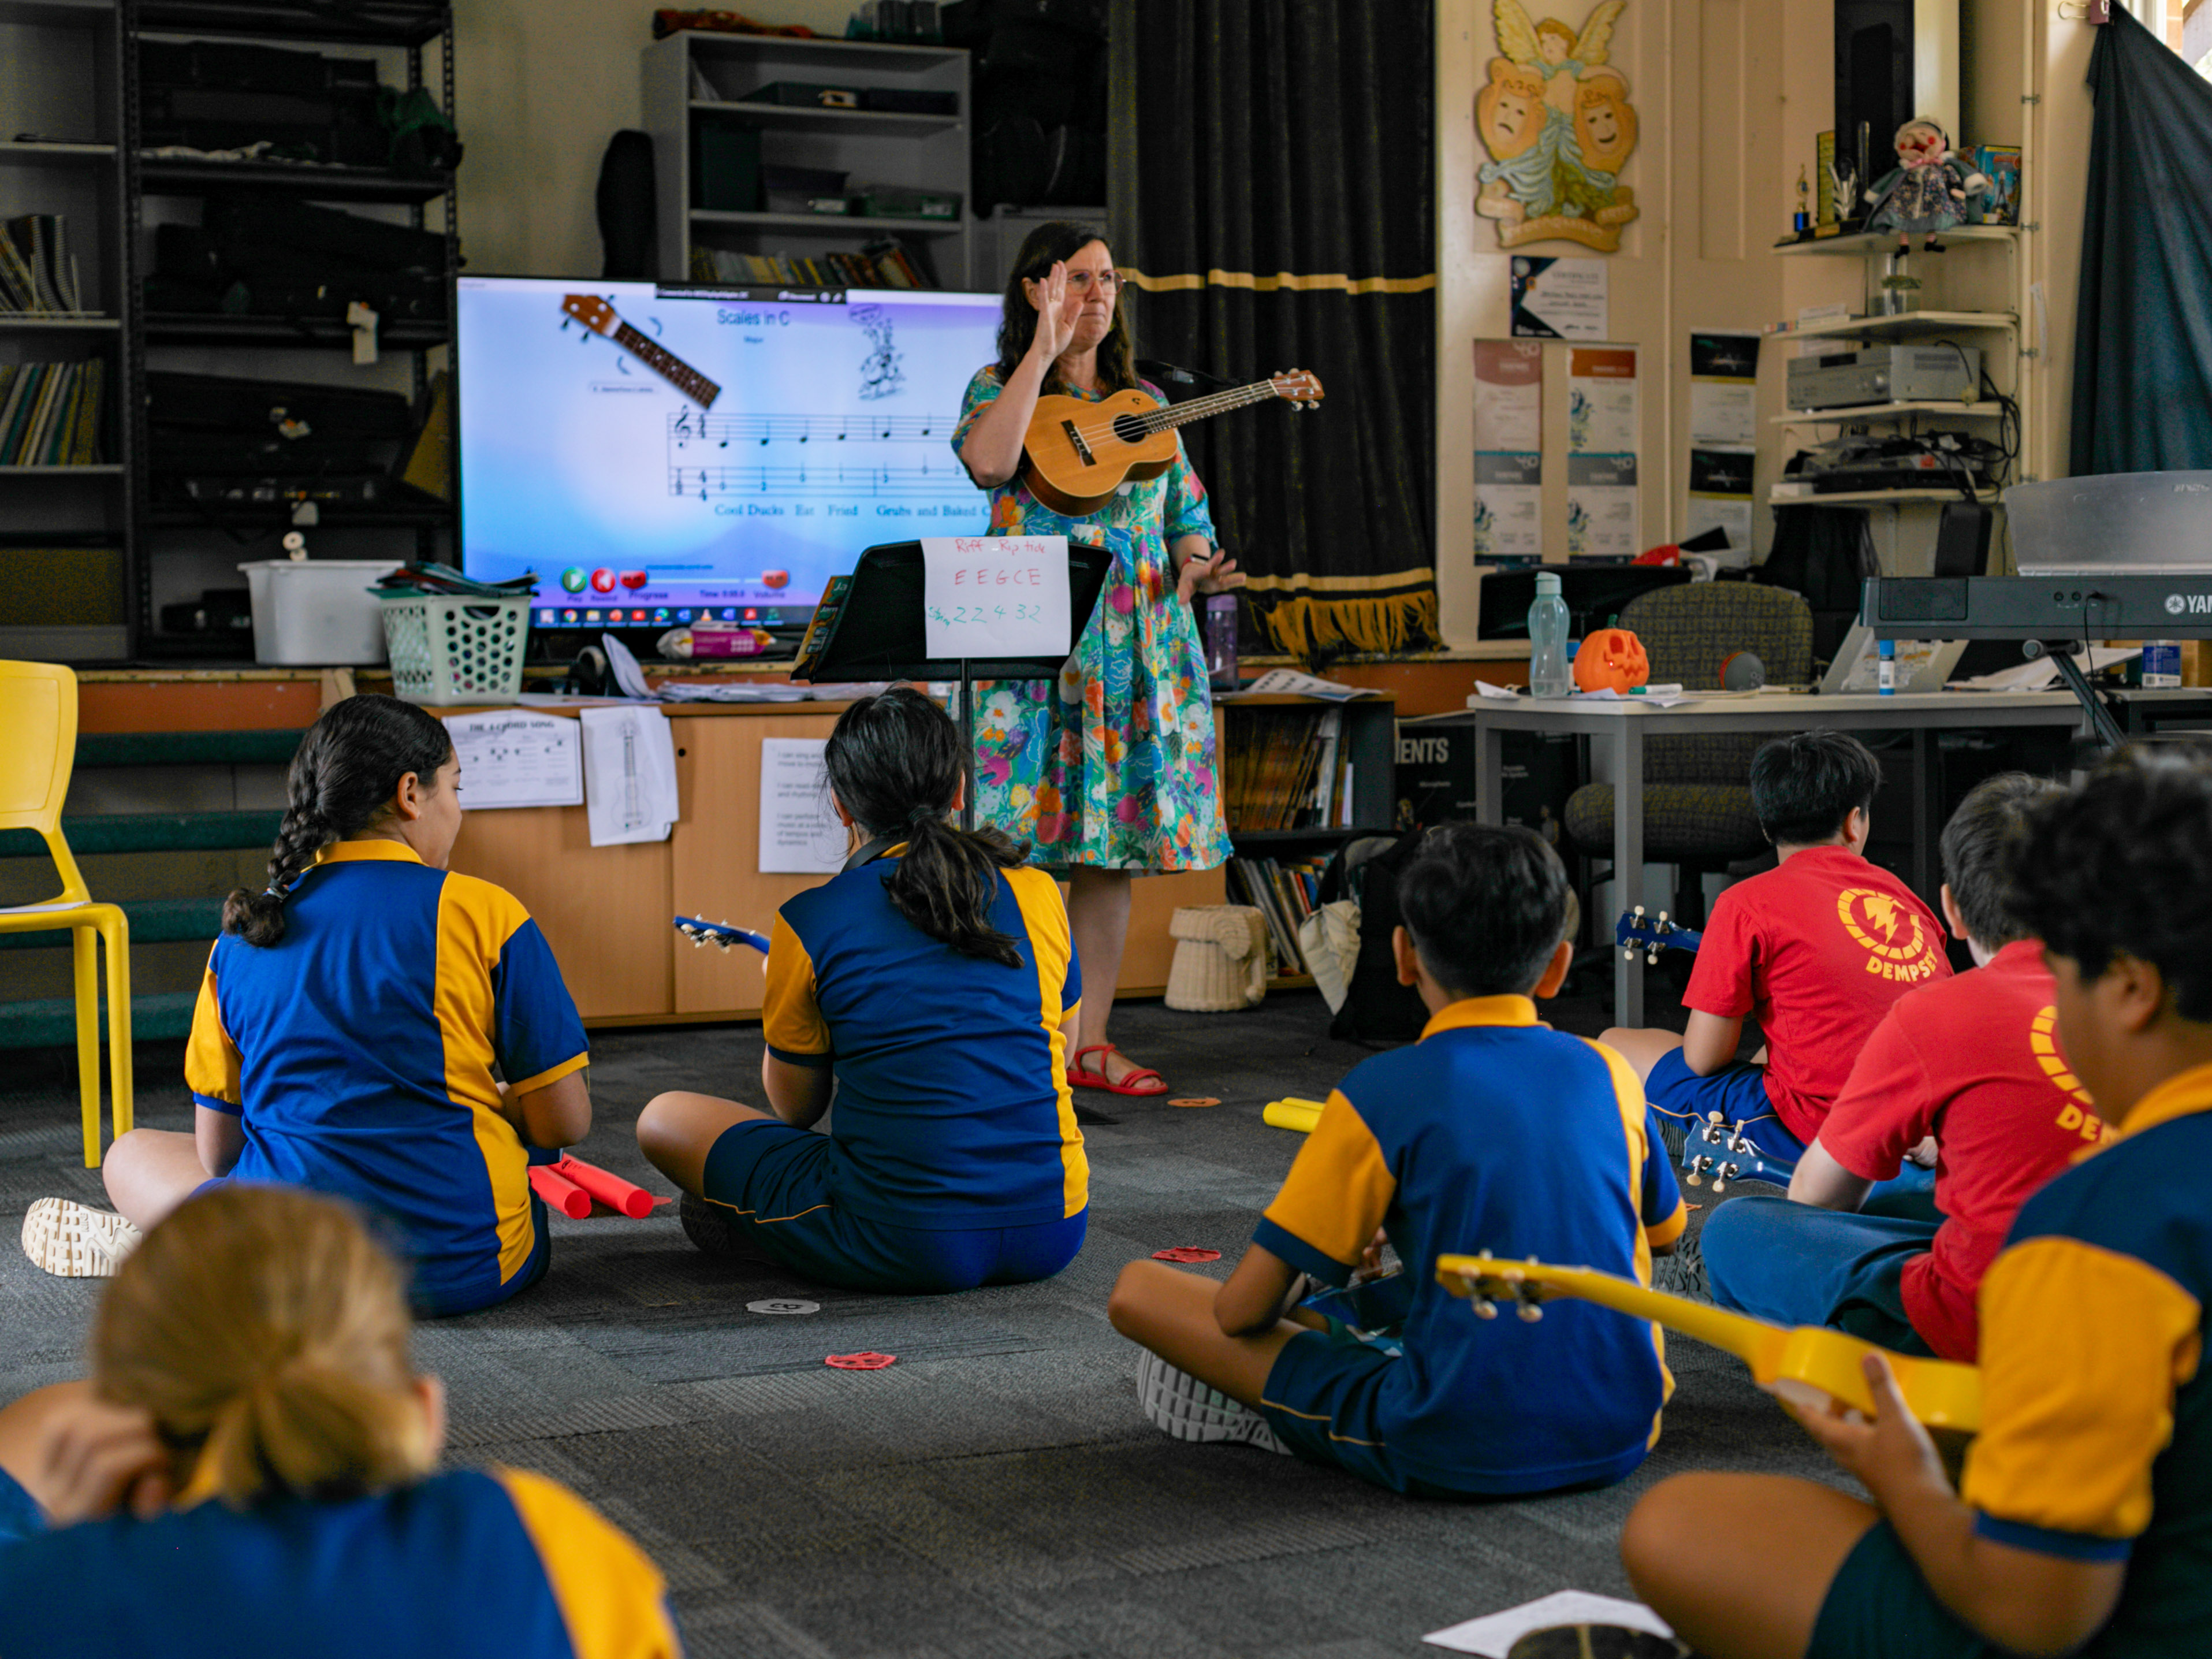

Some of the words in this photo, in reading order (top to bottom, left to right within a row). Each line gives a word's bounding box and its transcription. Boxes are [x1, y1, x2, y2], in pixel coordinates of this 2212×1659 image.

[717, 308, 761, 325] Scales
[764, 310, 776, 325] in
[779, 310, 790, 326] C
[714, 504, 743, 516] Cool
[747, 504, 784, 516] Ducks
[795, 504, 815, 516] Eat
[828, 504, 858, 516] Fried
[942, 505, 977, 516] Baked
[955, 538, 984, 554] Riff
[628, 591, 669, 600] Progress
[530, 720, 554, 729] SONG
[1865, 946, 1938, 983] DEMPSEY
